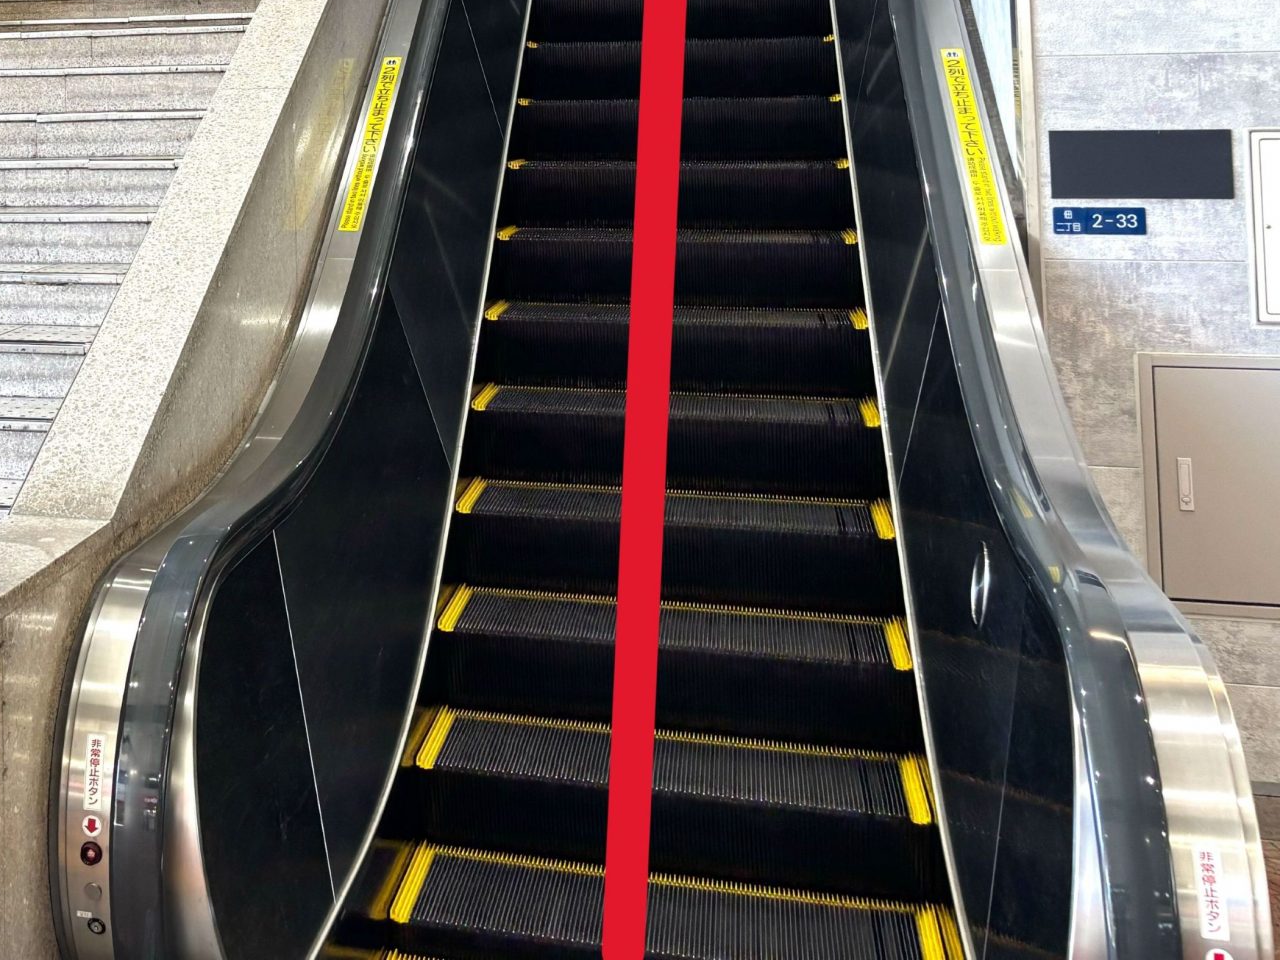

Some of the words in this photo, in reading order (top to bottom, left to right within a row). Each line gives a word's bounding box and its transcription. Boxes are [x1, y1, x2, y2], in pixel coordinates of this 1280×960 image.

[1056, 222, 1081, 232] 二丁目
[1092, 213, 1138, 228] 2-33
[88, 738, 102, 806] 非常停止ボタン
